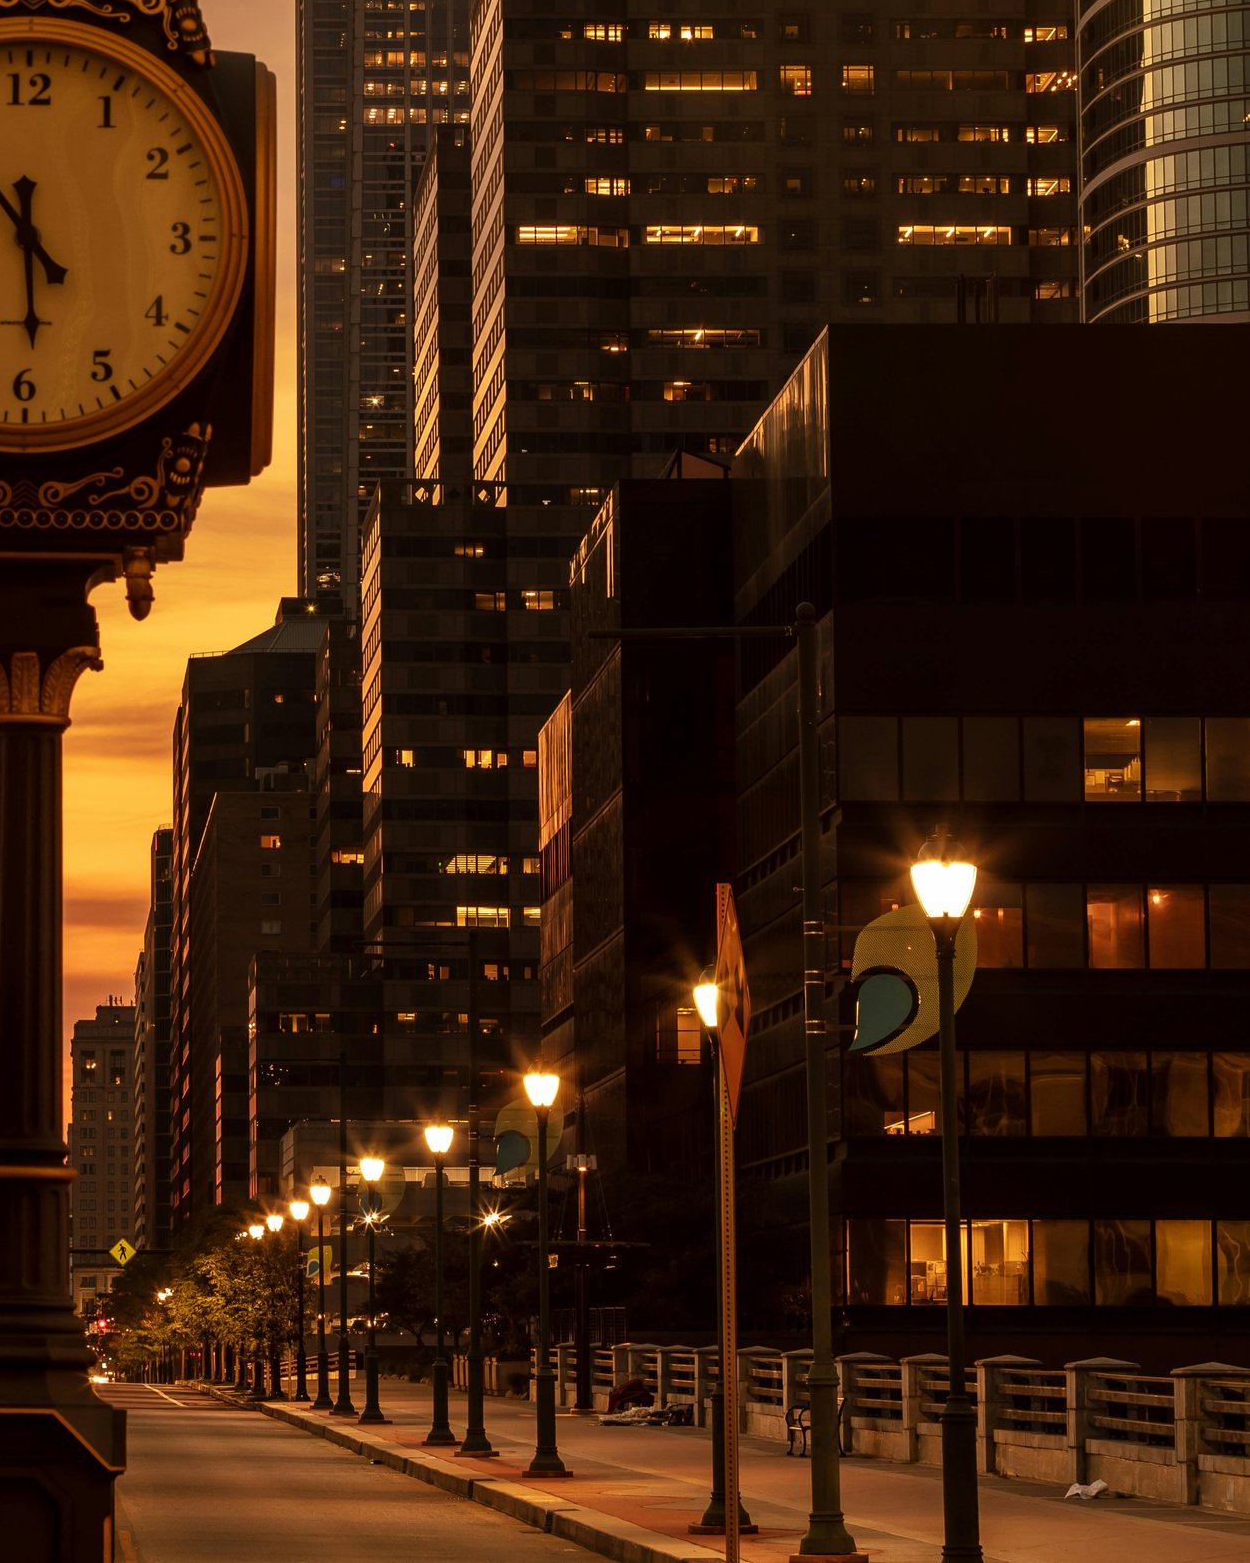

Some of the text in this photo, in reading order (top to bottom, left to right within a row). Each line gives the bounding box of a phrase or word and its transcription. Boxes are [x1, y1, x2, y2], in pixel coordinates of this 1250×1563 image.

[7, 73, 52, 106] 12
[97, 95, 117, 129] 1
[145, 147, 170, 181] 2
[169, 221, 193, 255] 3
[144, 294, 169, 327] 4
[90, 349, 114, 383] 5
[12, 368, 37, 402] 6
